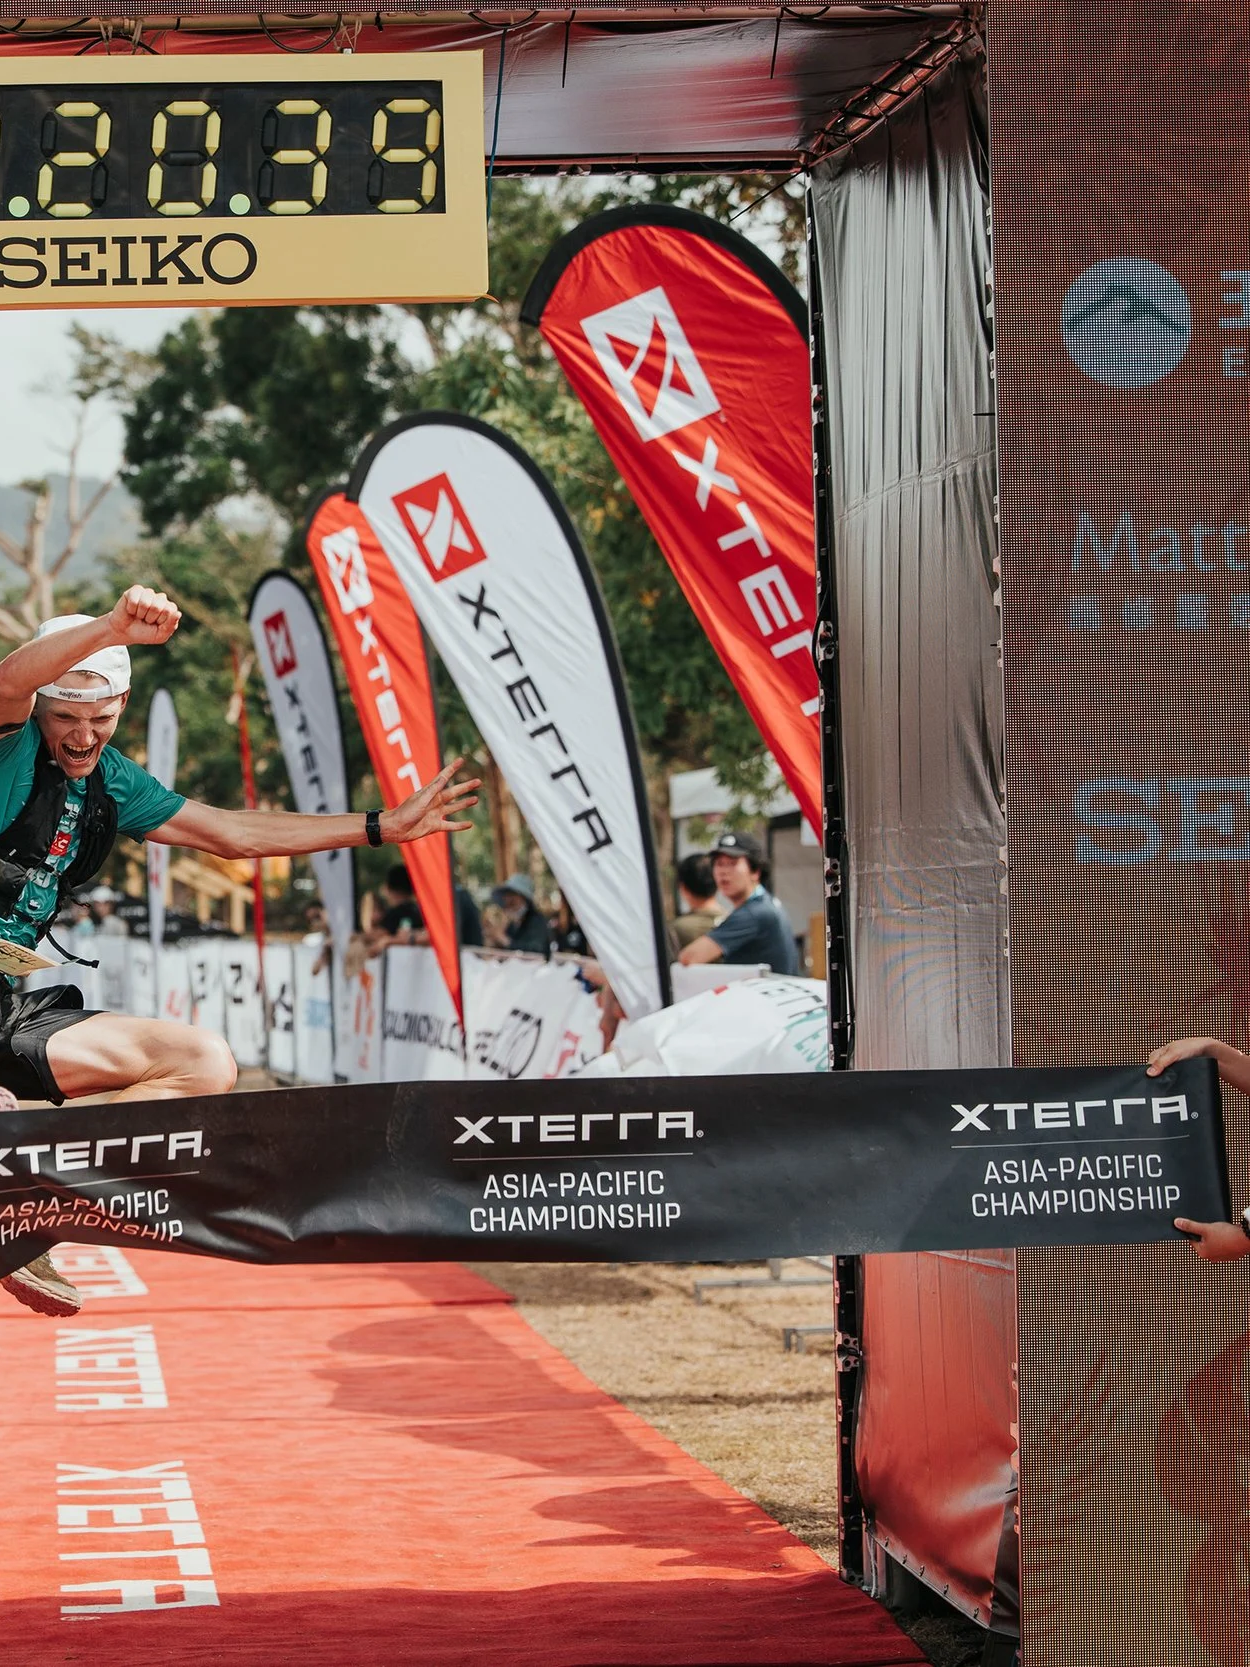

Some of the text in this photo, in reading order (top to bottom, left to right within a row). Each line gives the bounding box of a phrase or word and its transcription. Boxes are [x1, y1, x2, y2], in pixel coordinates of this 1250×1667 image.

[58, 690, 82, 699] sailfish
[354, 615, 423, 793] XTERR
[458, 582, 614, 855] XTERRA
[482, 1169, 665, 1200] ASIA-PACIFIC
[983, 1153, 1163, 1186] ASIA-PACIFIC
[971, 1184, 1181, 1218] CHAMPIONSHIP
[469, 1202, 682, 1234] CHAMPIONSHIP
[55, 1460, 221, 1616] XTERRA
